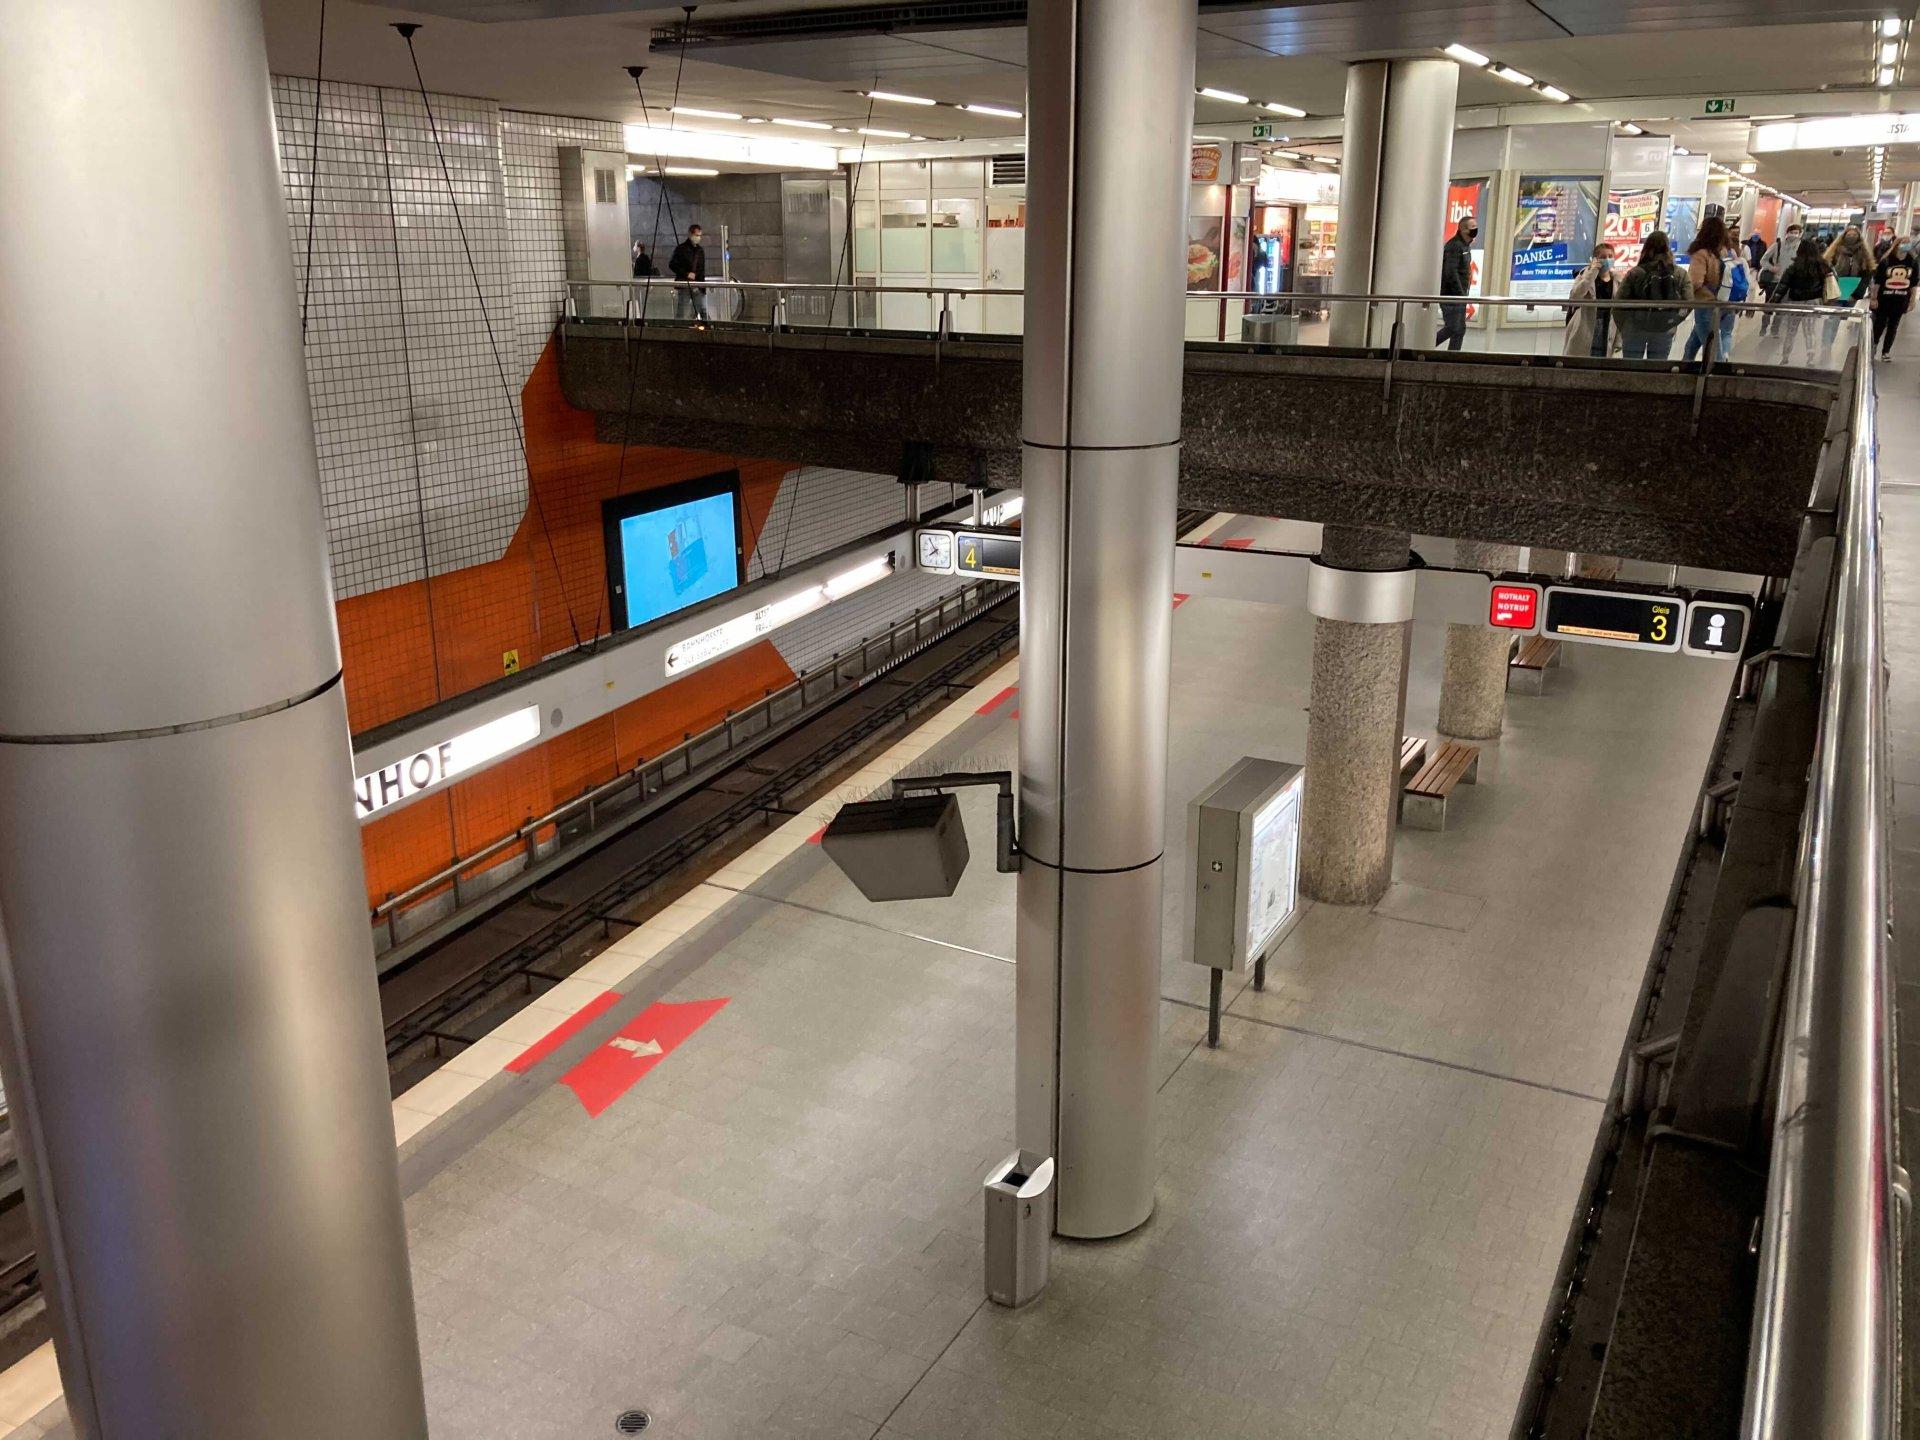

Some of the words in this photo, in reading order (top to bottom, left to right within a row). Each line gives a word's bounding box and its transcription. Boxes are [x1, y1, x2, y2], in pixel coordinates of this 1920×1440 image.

[1450, 200, 1474, 223] ibis
[1644, 222, 1650, 233] 6
[1514, 248, 1554, 266] DANKE
[965, 545, 977, 569] 4
[1498, 592, 1531, 602] NOTHALT
[1497, 602, 1530, 613] NOTRUF
[1651, 605, 1670, 615] Gleis
[1650, 615, 1667, 641] 3
